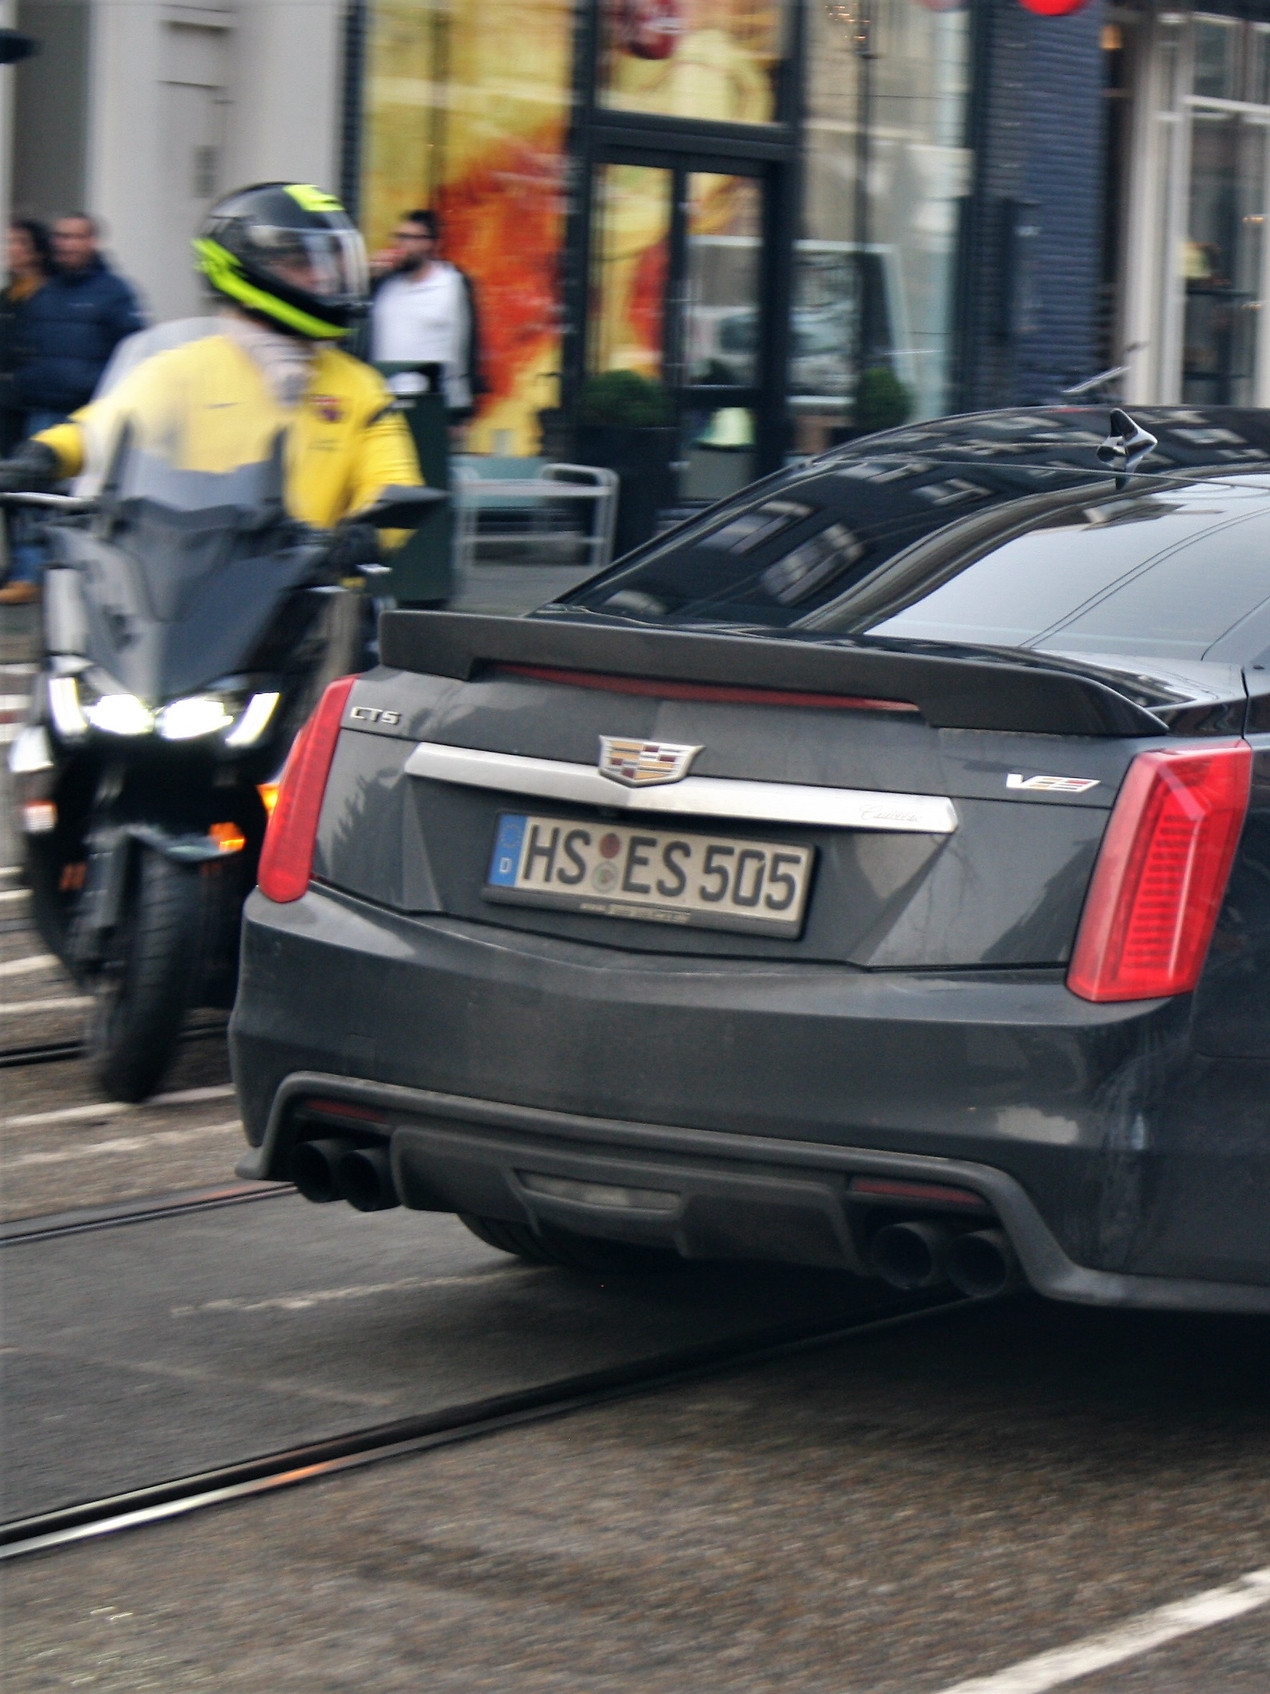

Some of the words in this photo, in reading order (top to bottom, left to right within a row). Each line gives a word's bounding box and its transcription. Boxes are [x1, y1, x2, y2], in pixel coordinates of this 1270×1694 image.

[350, 706, 401, 726] CTS
[522, 823, 591, 885] HS
[621, 836, 692, 897] ES
[699, 844, 802, 911] 505
